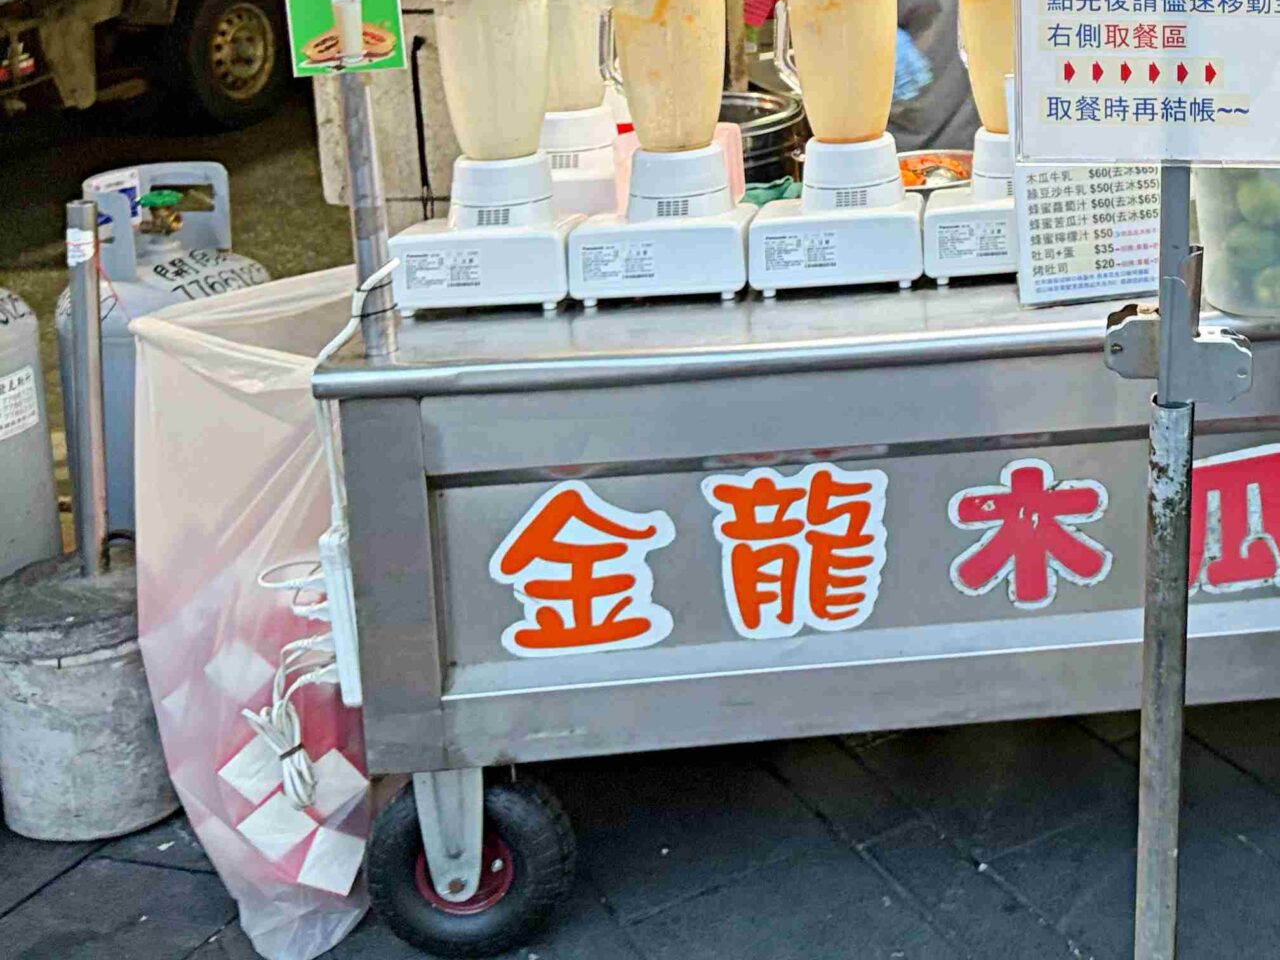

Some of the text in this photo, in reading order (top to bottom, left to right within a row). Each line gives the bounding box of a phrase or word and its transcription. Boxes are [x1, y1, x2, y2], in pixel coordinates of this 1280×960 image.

[1047, 22, 1188, 50] 右側取餐區
[490, 462, 888, 657] 金龍
